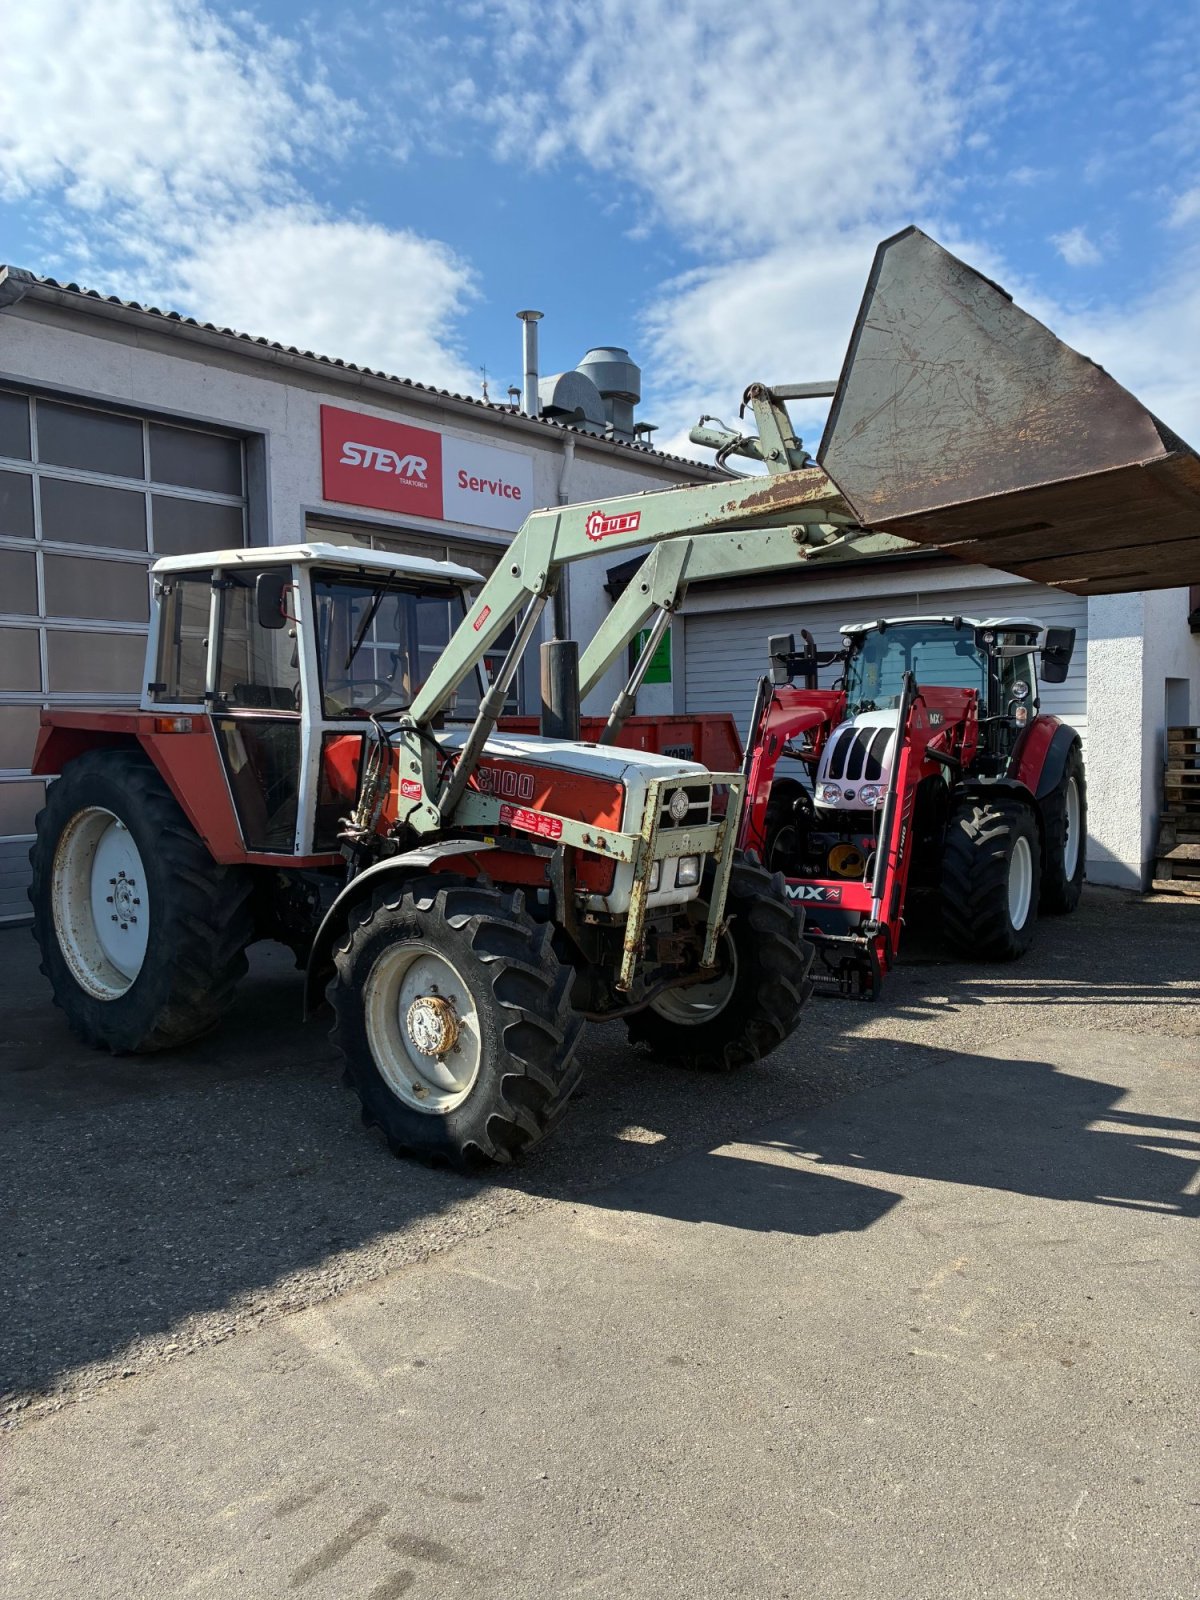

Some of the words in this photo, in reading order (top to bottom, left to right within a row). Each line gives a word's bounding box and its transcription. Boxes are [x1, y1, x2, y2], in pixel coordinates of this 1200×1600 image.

[340, 441, 428, 480] STEYR
[457, 469, 522, 500] Service
[785, 885, 825, 901] MX
